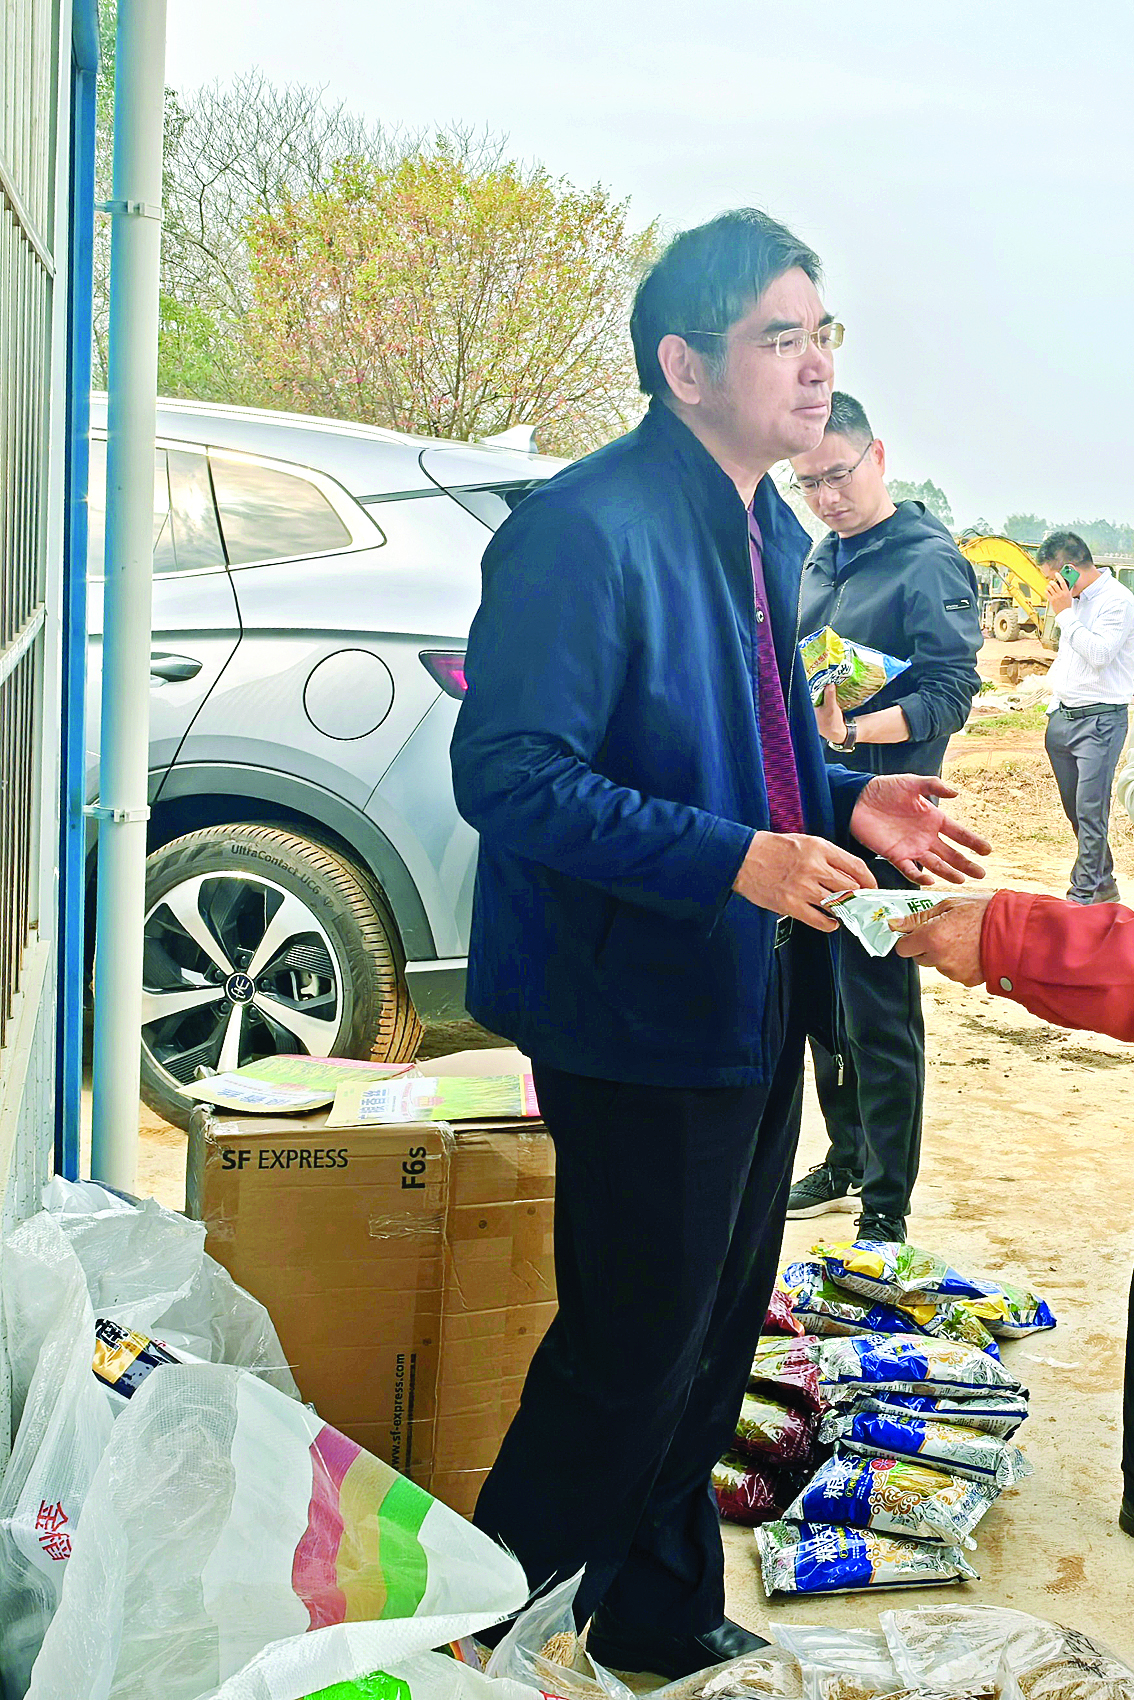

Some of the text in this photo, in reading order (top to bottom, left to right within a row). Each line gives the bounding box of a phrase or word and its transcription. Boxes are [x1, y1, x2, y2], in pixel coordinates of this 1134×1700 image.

[231, 845, 322, 895] UltraContact UC6
[221, 1148, 349, 1170] SF EXPRESS
[401, 1146, 427, 1189] F6s
